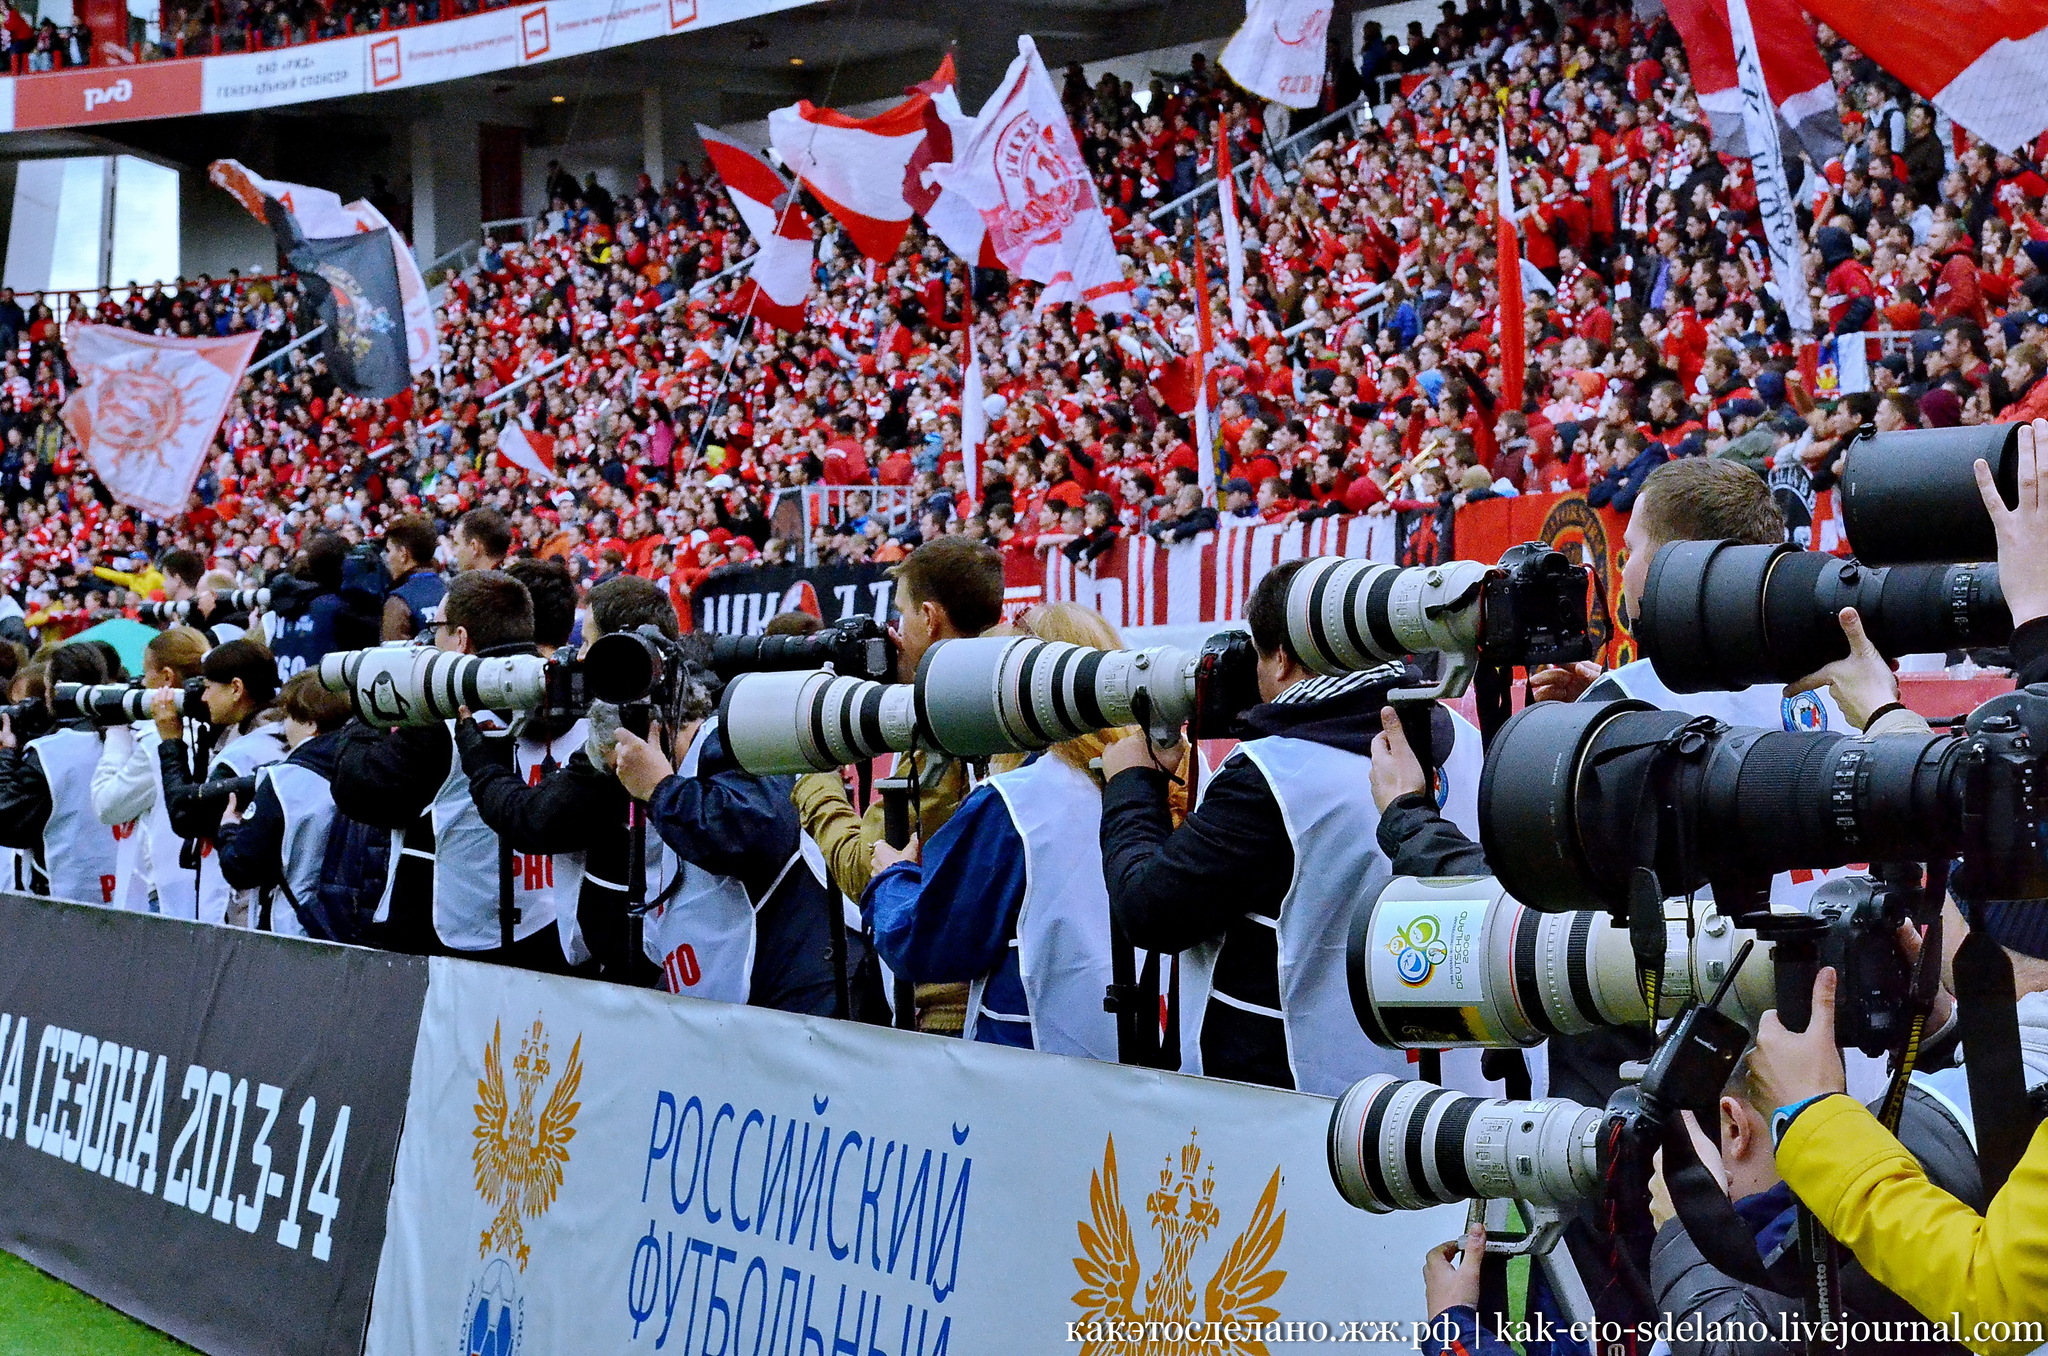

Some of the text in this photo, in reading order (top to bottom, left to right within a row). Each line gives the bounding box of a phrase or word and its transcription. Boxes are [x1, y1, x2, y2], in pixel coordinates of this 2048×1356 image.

[217, 69, 348, 99] ГЕНЕРАЛЬНЫЙ СПОНСОР
[1456, 911, 1468, 990] DEUTSCHLAND
[1462, 934, 1471, 964] 2006
[25, 1024, 168, 1195] СЕЗОНА
[163, 1064, 351, 1263] 2013-14
[641, 1091, 973, 1294] РОССИЙСКИЙ
